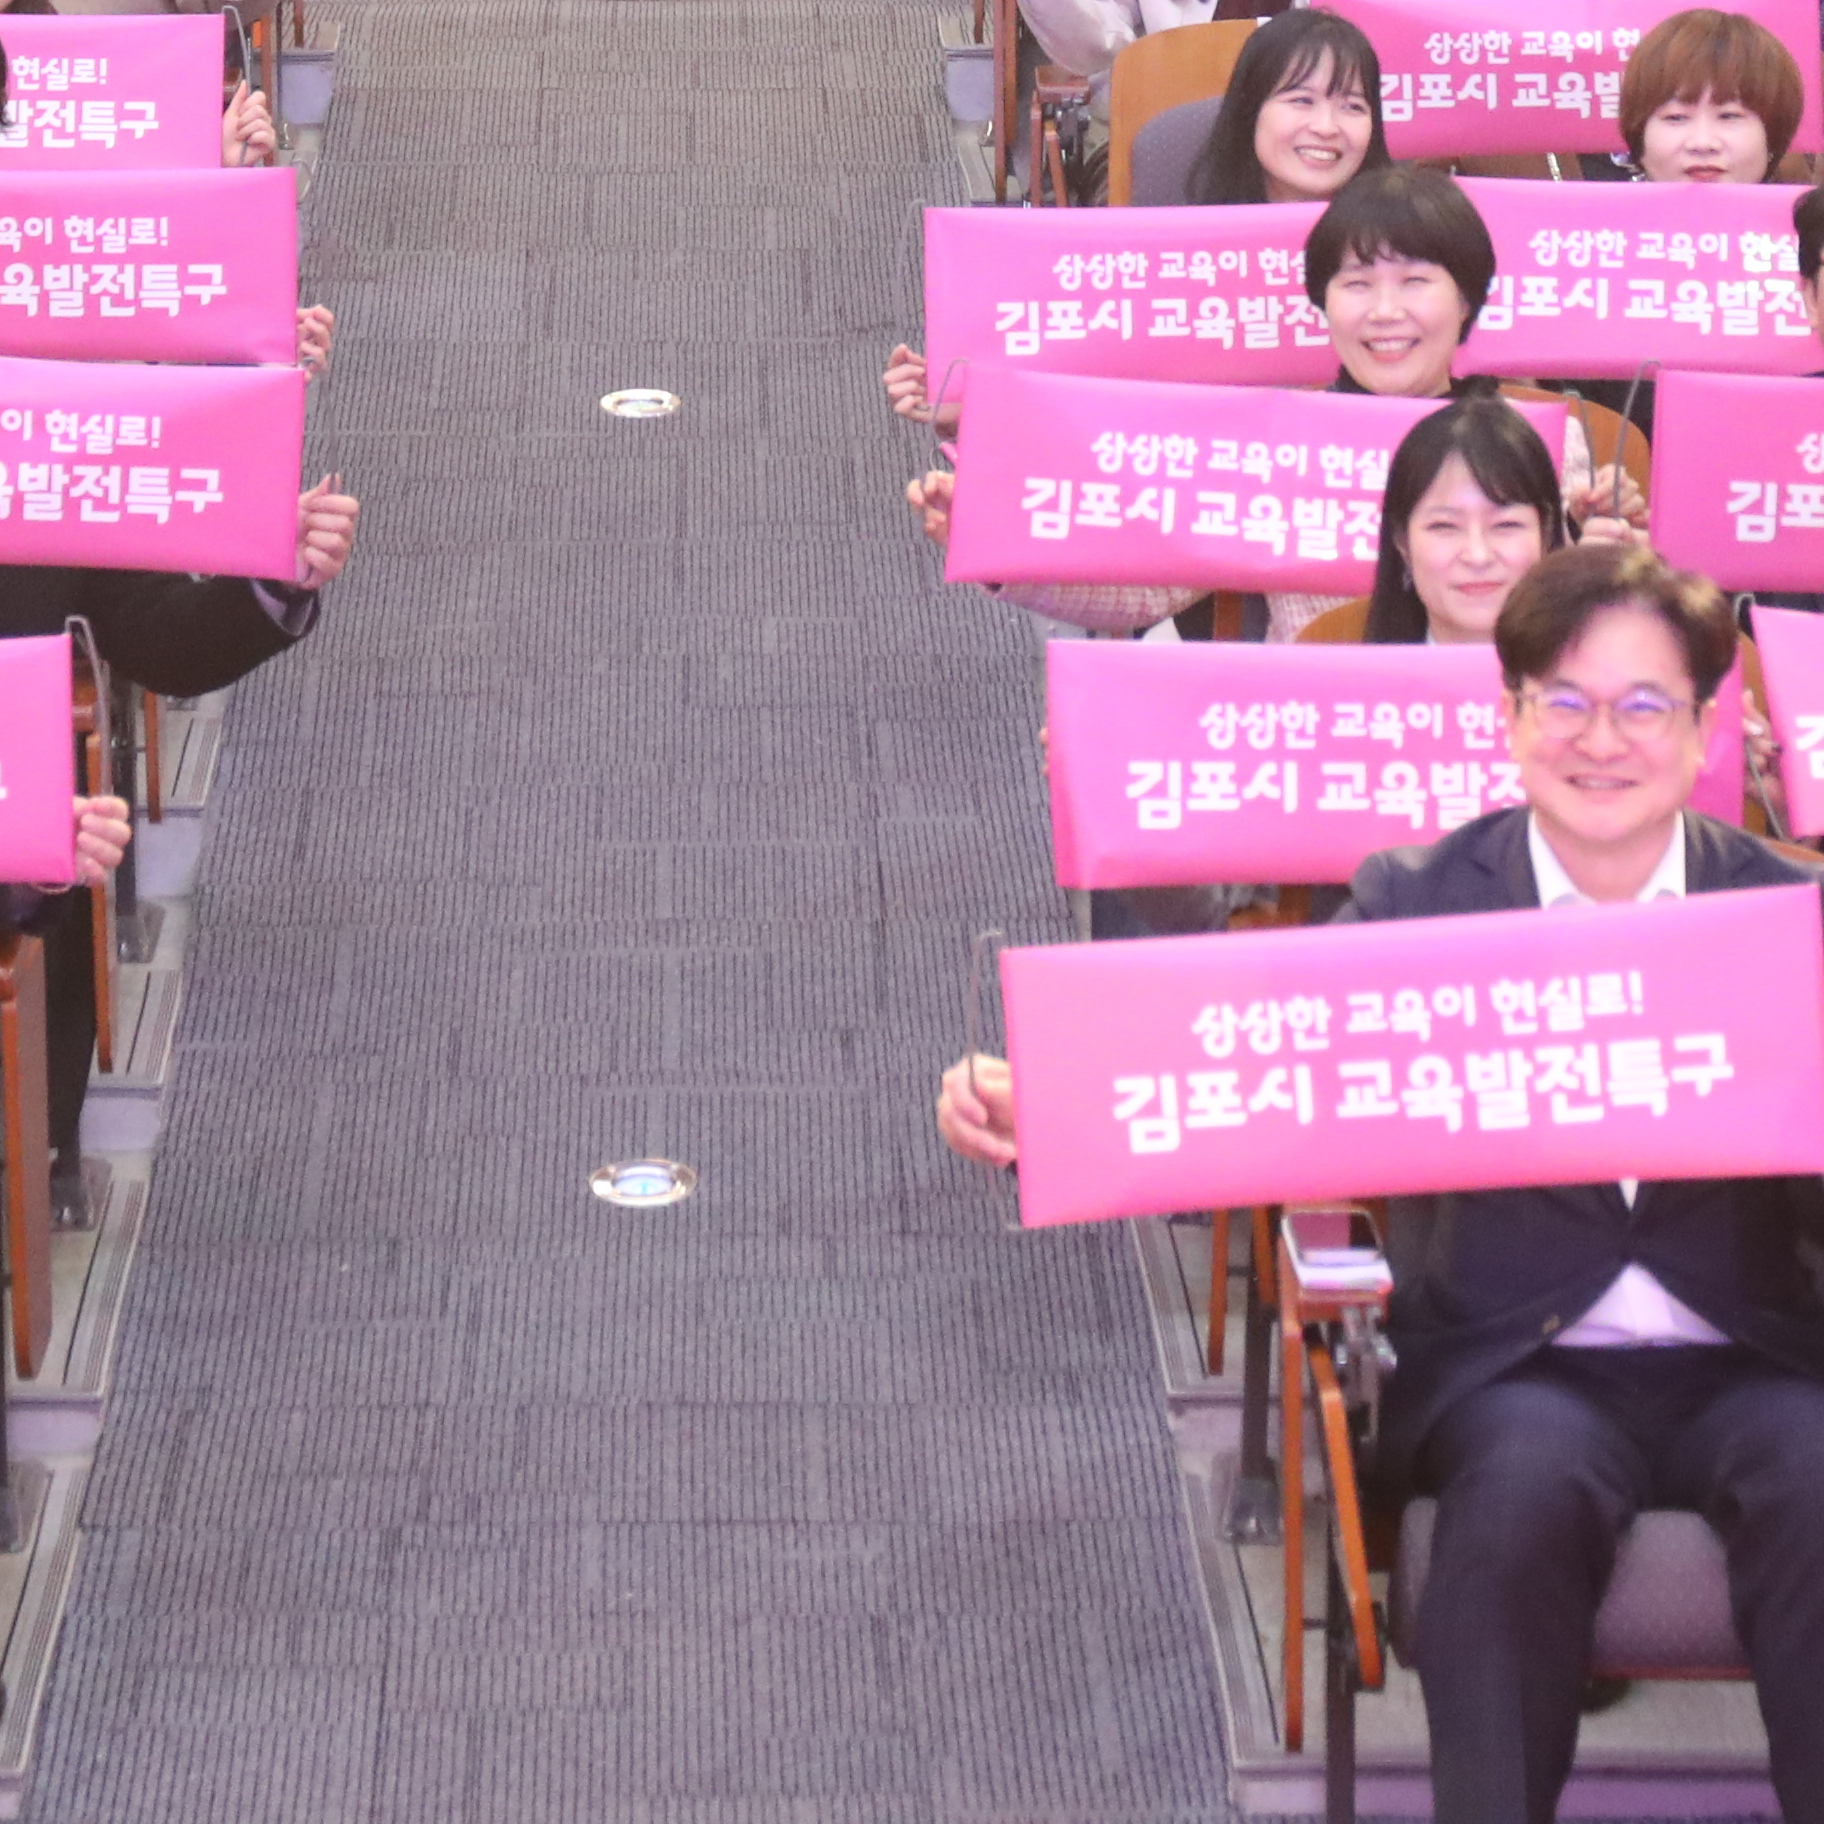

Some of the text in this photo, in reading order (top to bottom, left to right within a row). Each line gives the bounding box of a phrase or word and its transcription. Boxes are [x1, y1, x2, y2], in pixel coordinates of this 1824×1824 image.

[44, 408, 162, 455] 현실로!
[1191, 969, 1644, 1058] 상상한 교육이 현실로!
[1112, 1032, 1737, 1156] 김포시 교육발전특구
